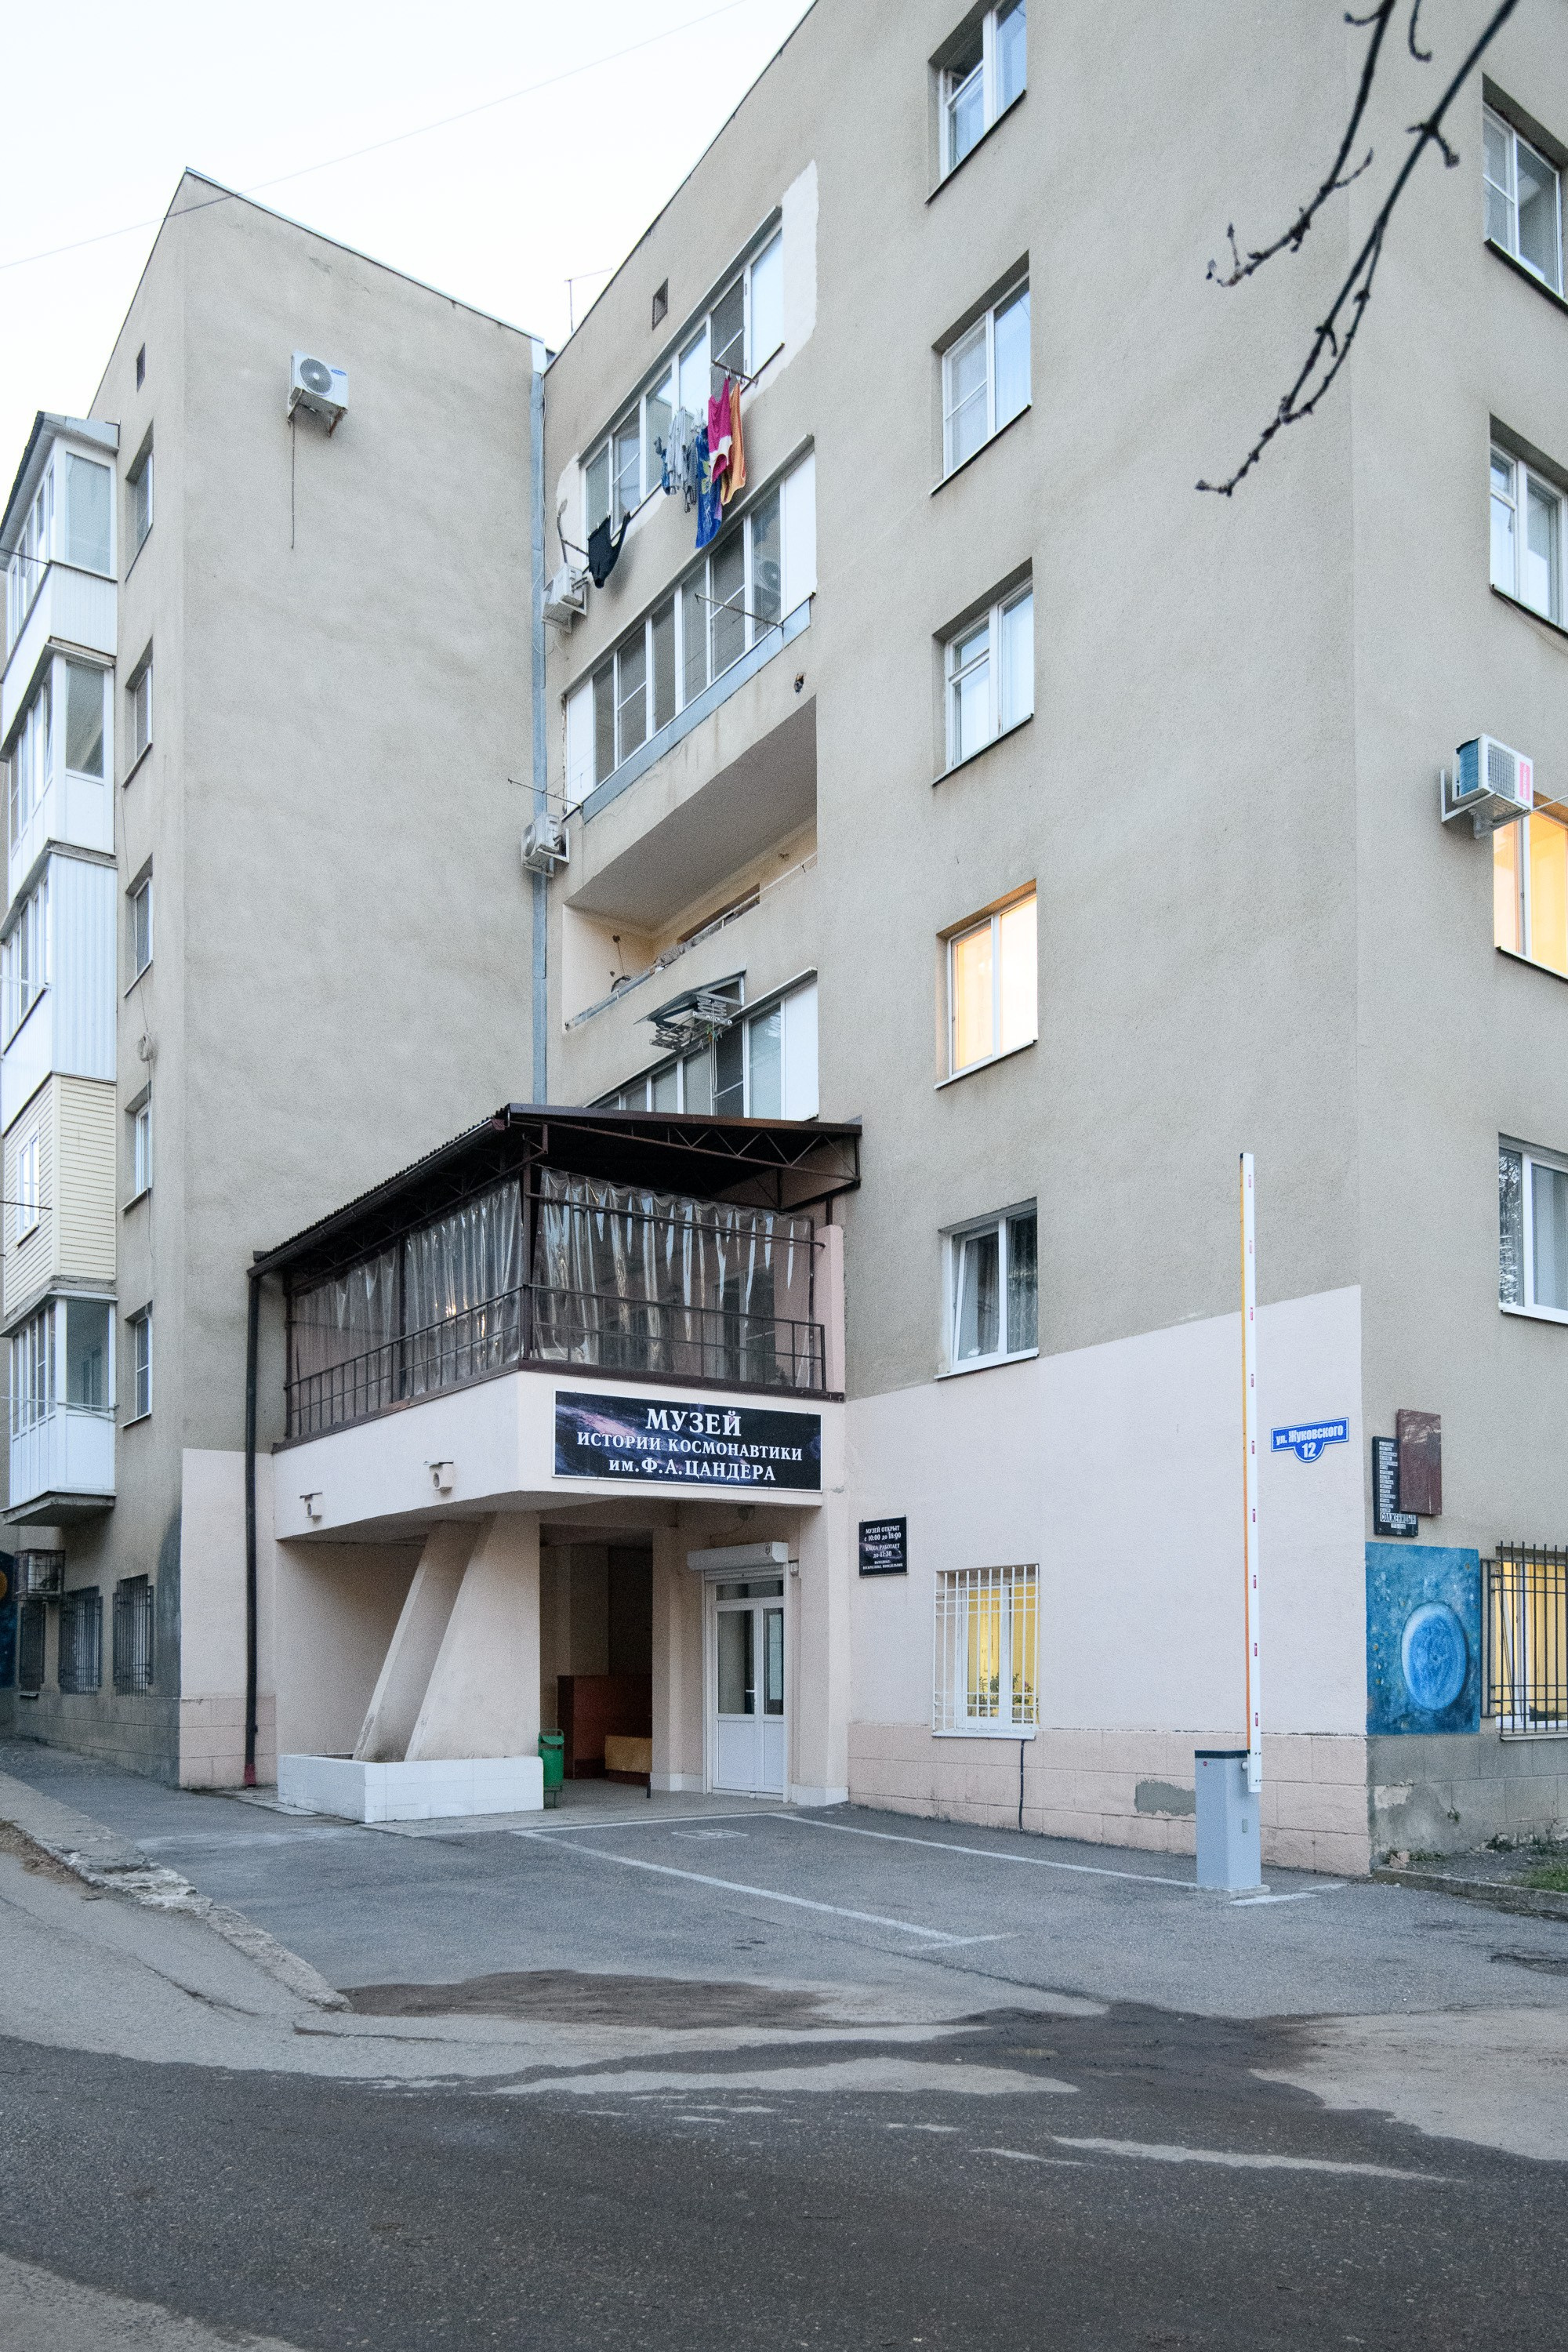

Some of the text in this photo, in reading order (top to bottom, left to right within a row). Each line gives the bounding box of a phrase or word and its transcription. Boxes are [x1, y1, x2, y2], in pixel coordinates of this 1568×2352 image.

[645, 1408, 742, 1436] МУЗЕЙ
[576, 1431, 803, 1461] ИСТОРИИ КОСМОНАВТИКИ
[1276, 1425, 1344, 1446] ул. Жуковского
[1301, 1442, 1316, 1458] 12
